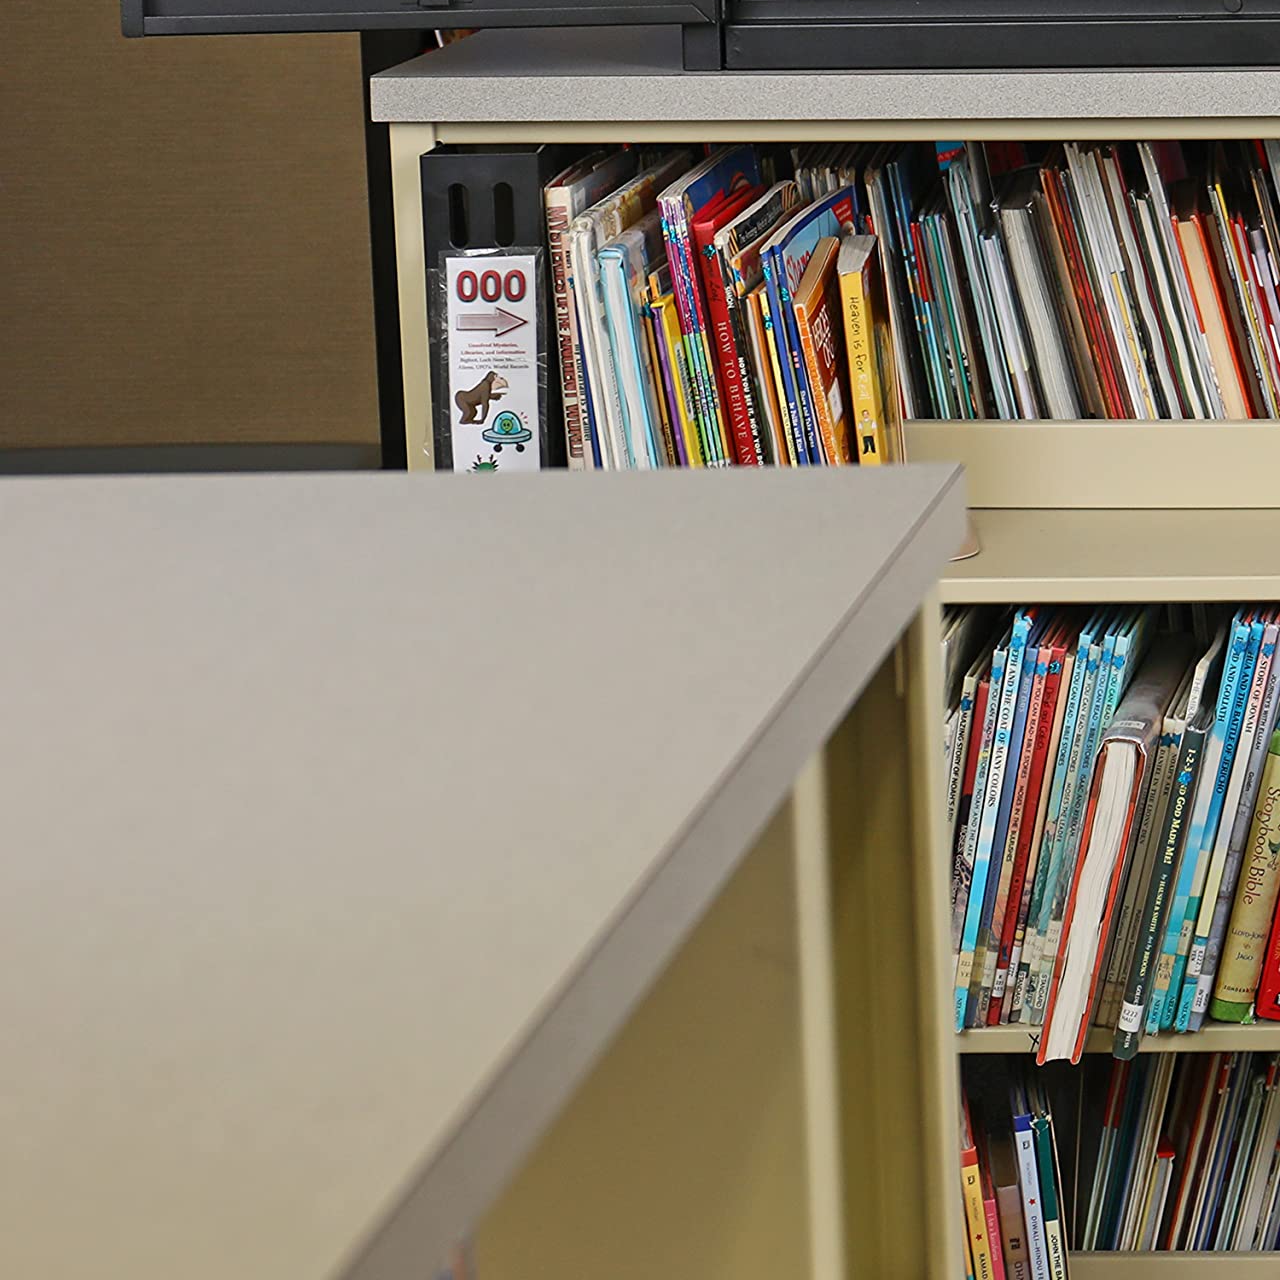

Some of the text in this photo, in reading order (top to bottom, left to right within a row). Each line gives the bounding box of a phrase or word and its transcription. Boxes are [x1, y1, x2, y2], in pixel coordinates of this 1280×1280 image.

[456, 269, 527, 303] 000
[716, 320, 731, 353] HOW
[848, 295, 870, 400] Heaven is for Real
[724, 359, 736, 379] TO
[729, 384, 748, 439] BEHAVE
[1216, 663, 1236, 721] AND GOLIATH
[1245, 660, 1267, 733] STORY OF JONAH
[988, 633, 1020, 807] JEPH AND THE COAT OF MANY COLORS
[1215, 671, 1249, 793] AND THE BATTLE OF JERICHO
[1163, 748, 1195, 864] 1-2-3 GOD MADE ME!
[1243, 786, 1280, 906] Storybook Bible
[1013, 971, 1024, 1005] STANDARD
[1036, 973, 1047, 1007] STANDARD
[1049, 1233, 1060, 1253] JOHN
[1053, 1254, 1062, 1268] THE
